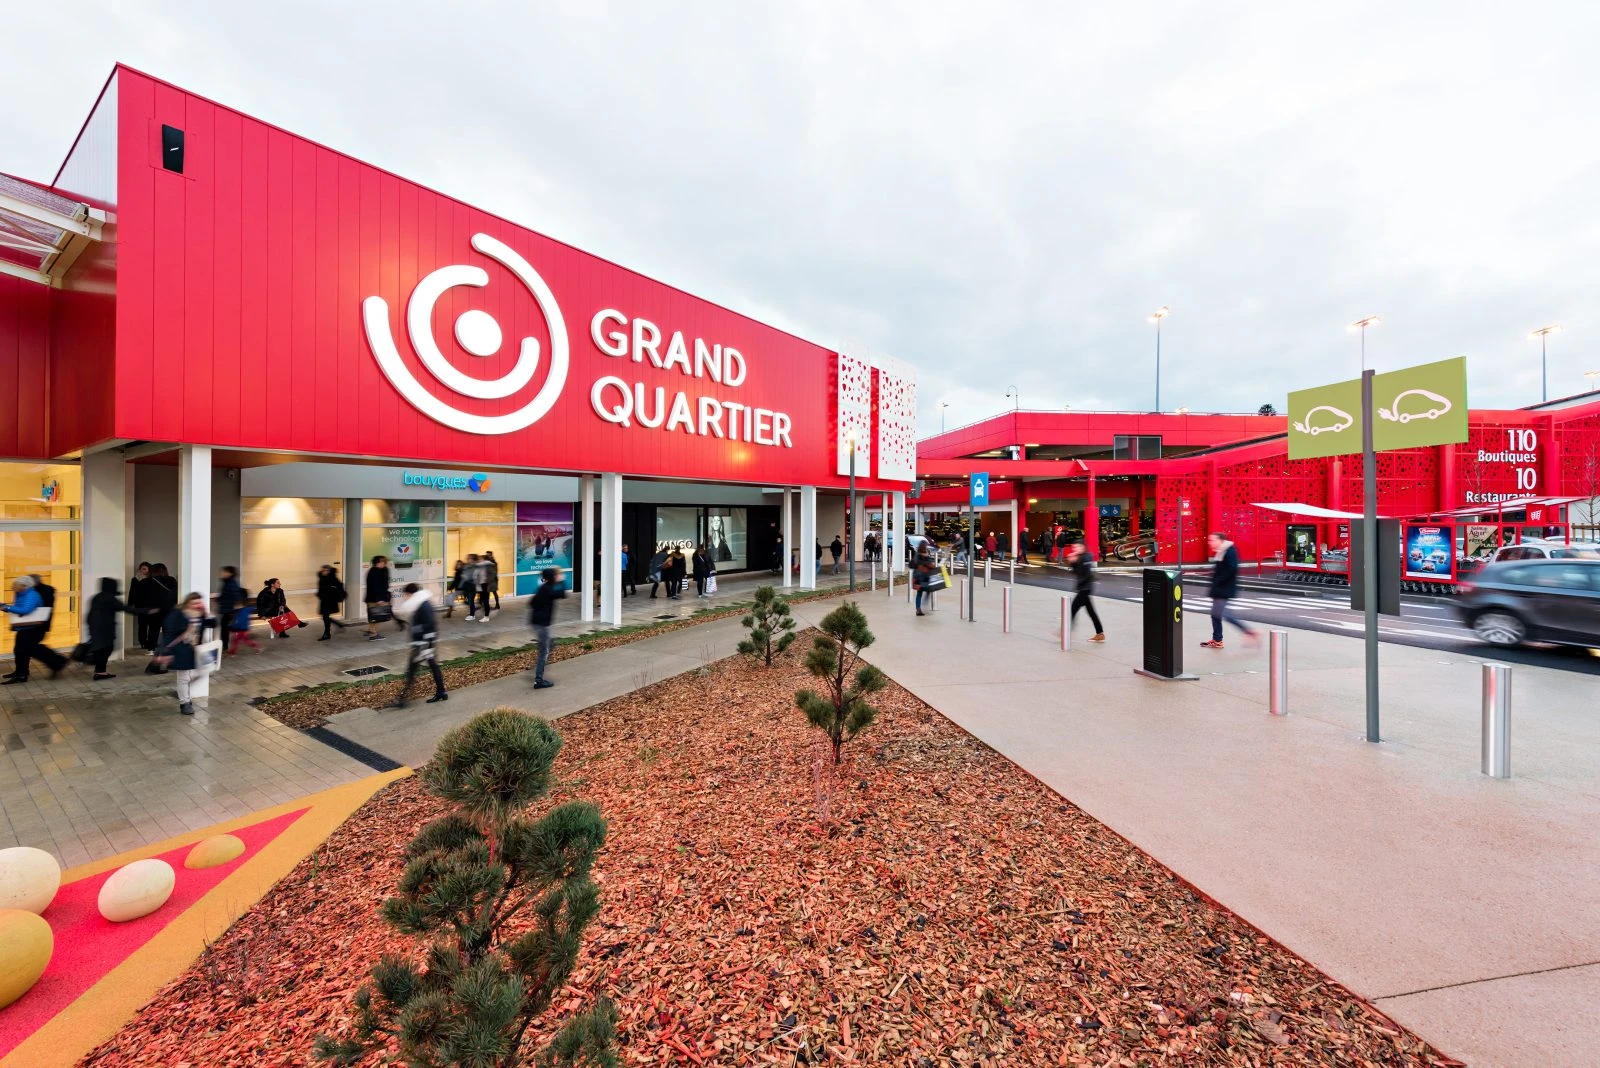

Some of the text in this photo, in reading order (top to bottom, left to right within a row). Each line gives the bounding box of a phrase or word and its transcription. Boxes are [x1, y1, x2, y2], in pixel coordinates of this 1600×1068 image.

[591, 308, 747, 387] GRAND
[591, 376, 793, 448] QUARTIER
[1508, 429, 1537, 451] 110
[1478, 450, 1537, 464] Boutiques
[404, 471, 467, 489] bouygues
[1516, 467, 1537, 490] 10
[1466, 491, 1537, 503] Restaura
[381, 535, 424, 543] technology
